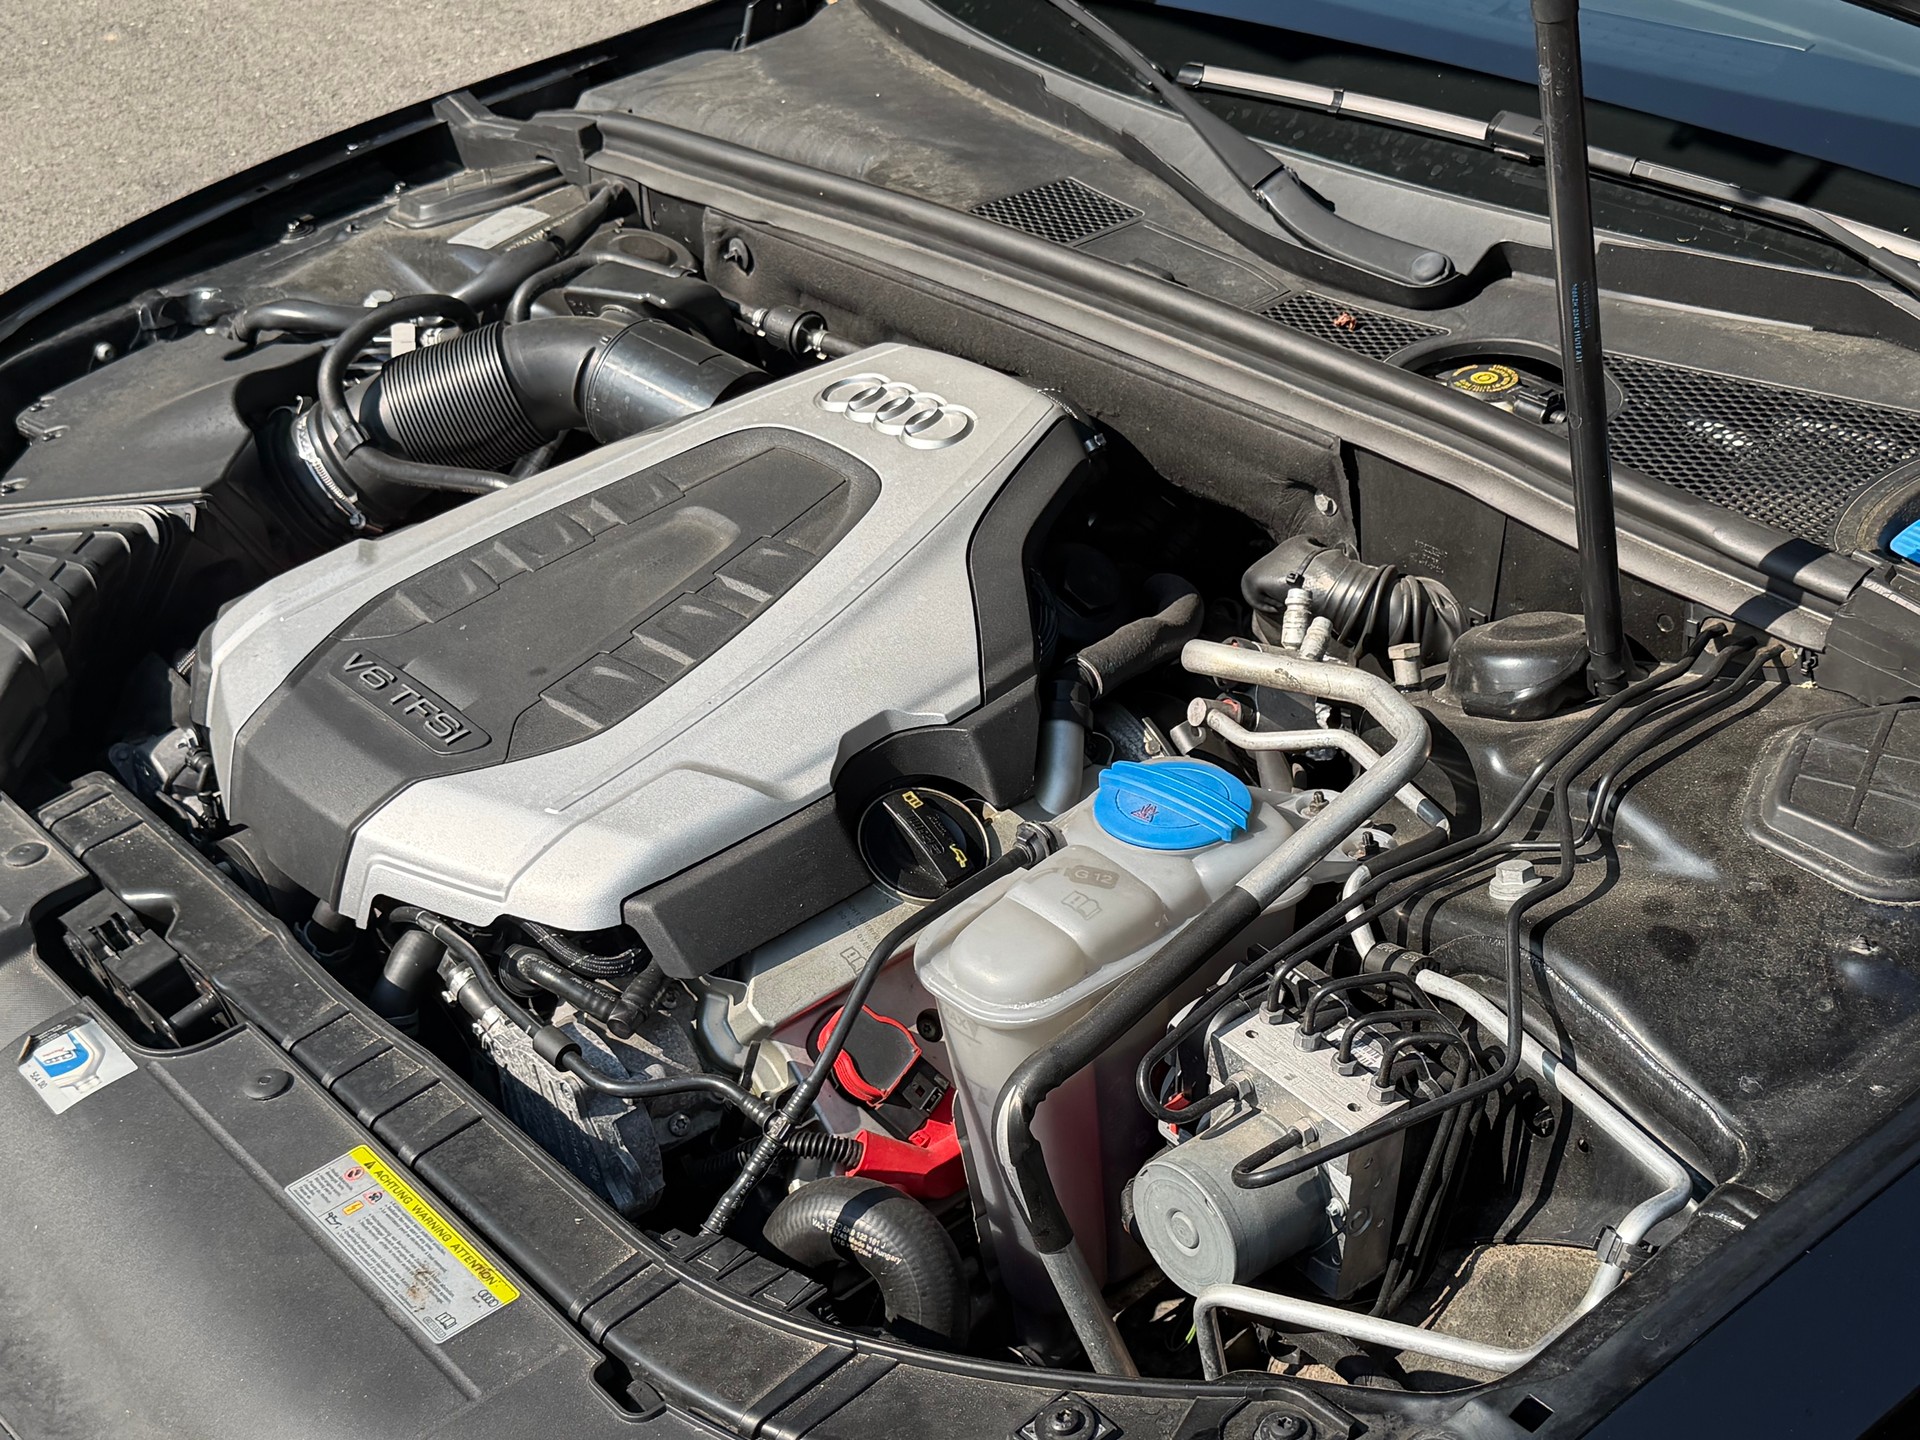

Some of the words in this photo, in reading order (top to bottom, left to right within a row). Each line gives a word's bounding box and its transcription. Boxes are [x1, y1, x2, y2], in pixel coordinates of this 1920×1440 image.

[343, 652, 398, 691] V6
[390, 683, 472, 747] TFSI
[1074, 869, 1089, 879] G
[1093, 873, 1113, 885] 12
[372, 1170, 413, 1204] ACHTUNG
[411, 1204, 452, 1242] WARNING
[449, 1243, 498, 1285] ATTENTION
[812, 1217, 824, 1231] VAC
[873, 1247, 902, 1265] Hungary
